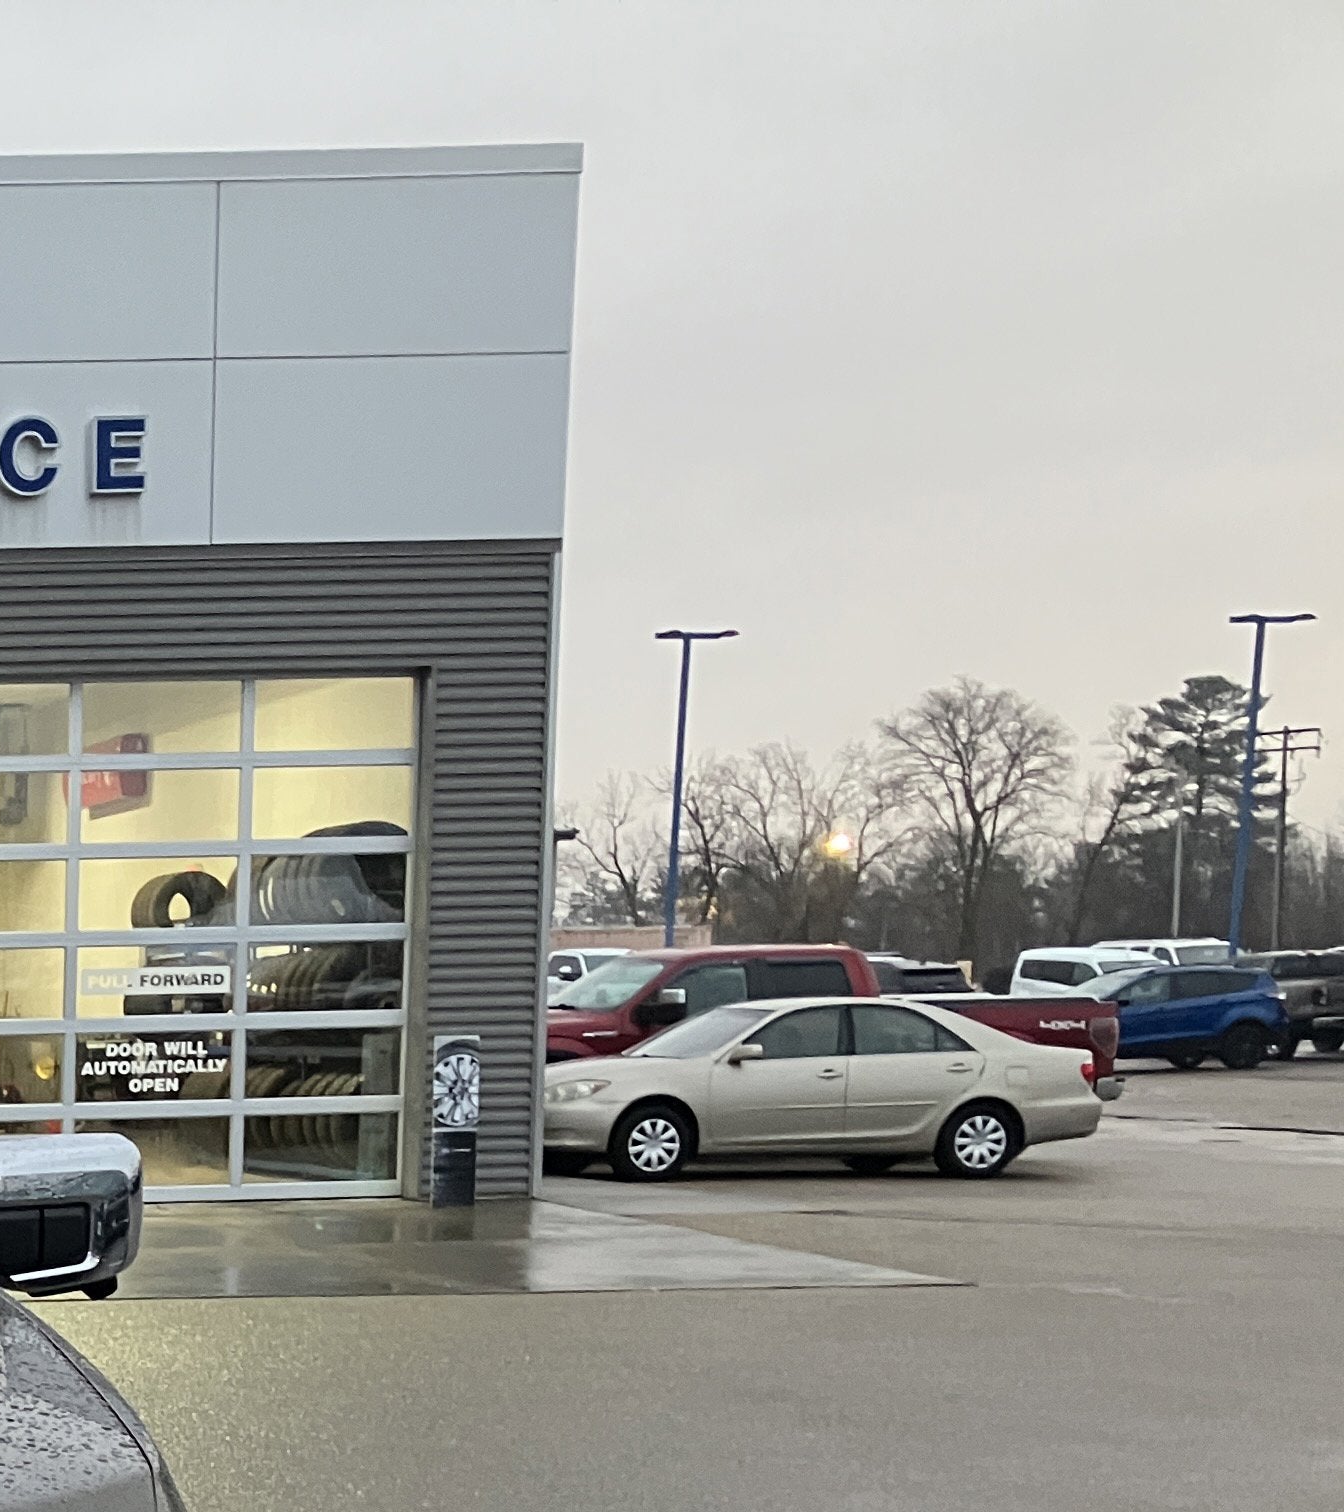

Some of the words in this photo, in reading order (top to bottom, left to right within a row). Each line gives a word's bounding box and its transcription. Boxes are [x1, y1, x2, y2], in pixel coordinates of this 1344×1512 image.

[88, 974, 133, 989] PULL
[140, 973, 224, 987] FORWARD
[106, 1042, 157, 1057] DOOR
[164, 1041, 208, 1057] WILL
[81, 1059, 227, 1076] AUTOMATICALLY
[128, 1078, 179, 1093] OPEN
